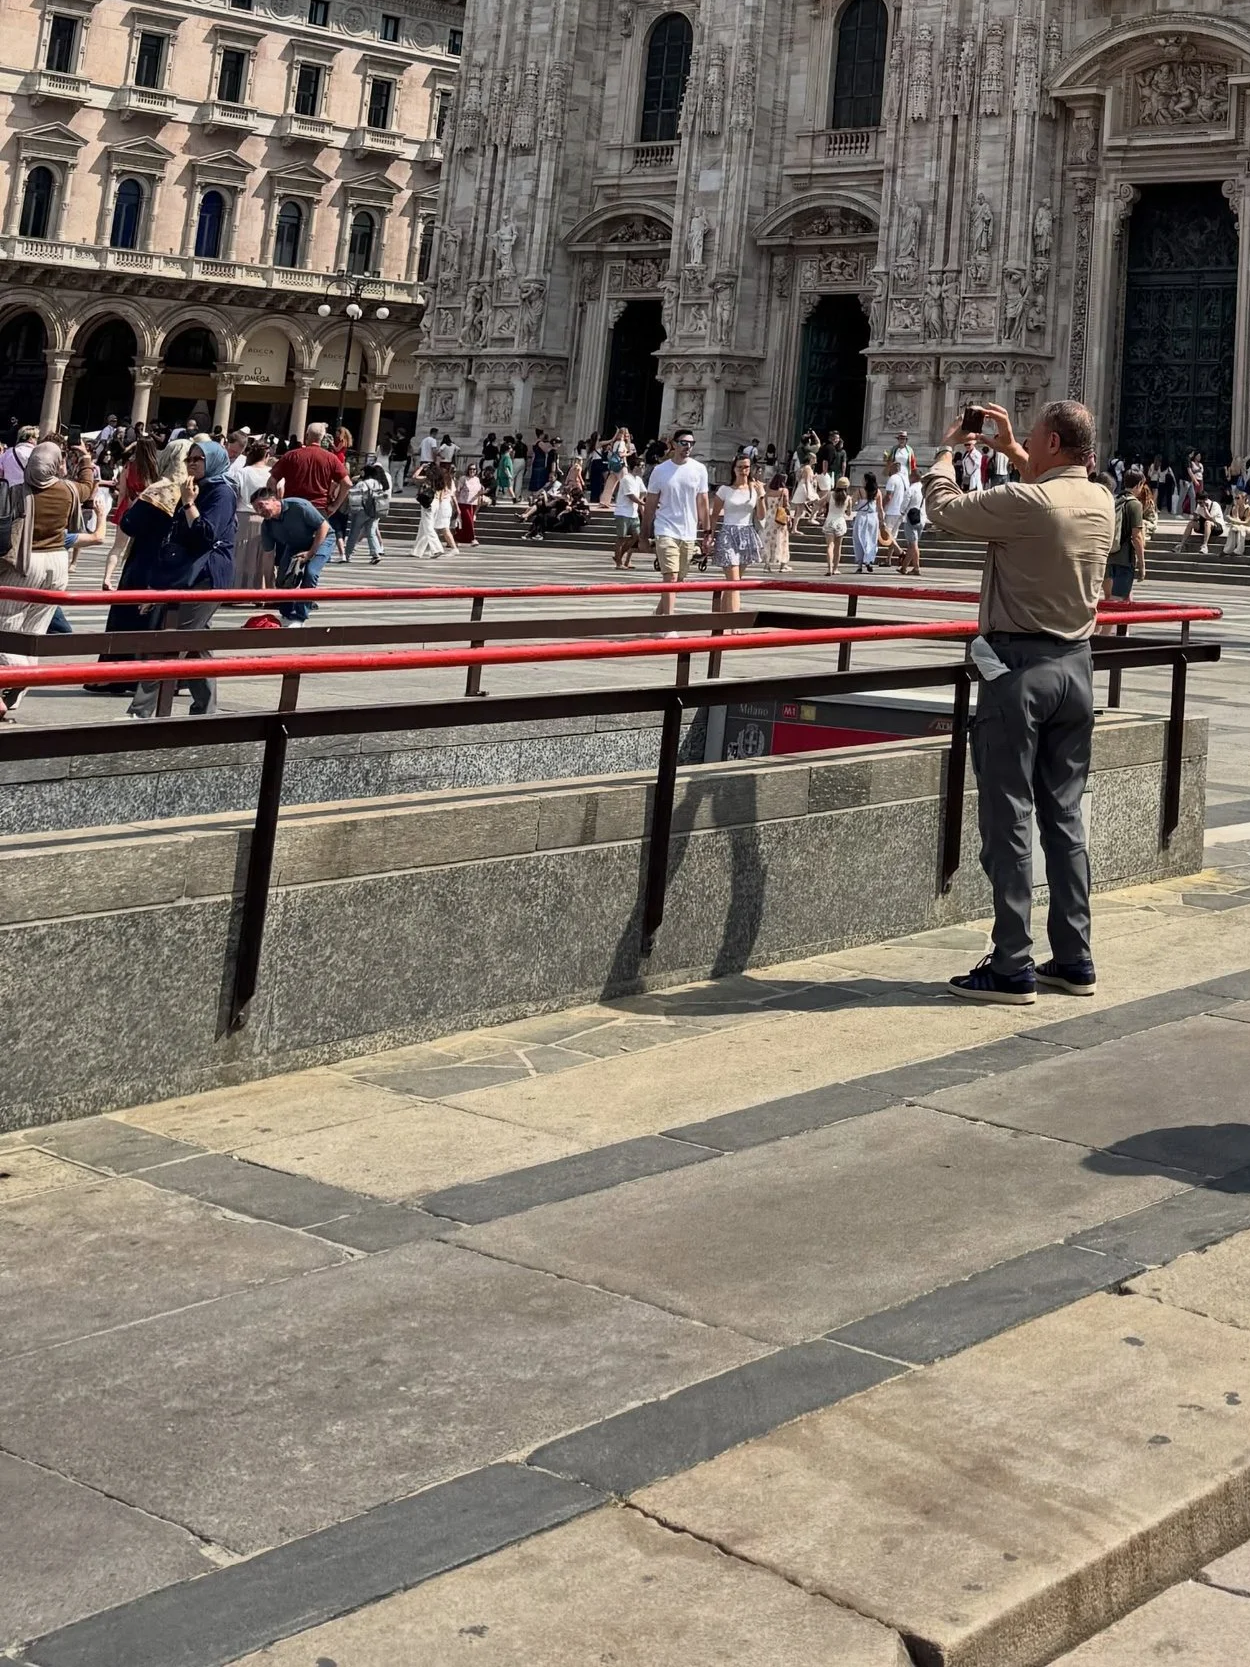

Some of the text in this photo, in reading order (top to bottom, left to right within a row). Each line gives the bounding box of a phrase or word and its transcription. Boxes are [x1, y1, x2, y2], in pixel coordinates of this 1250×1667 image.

[244, 375, 271, 383] OMEGA
[739, 703, 769, 716] Milano
[783, 707, 796, 716] M1
